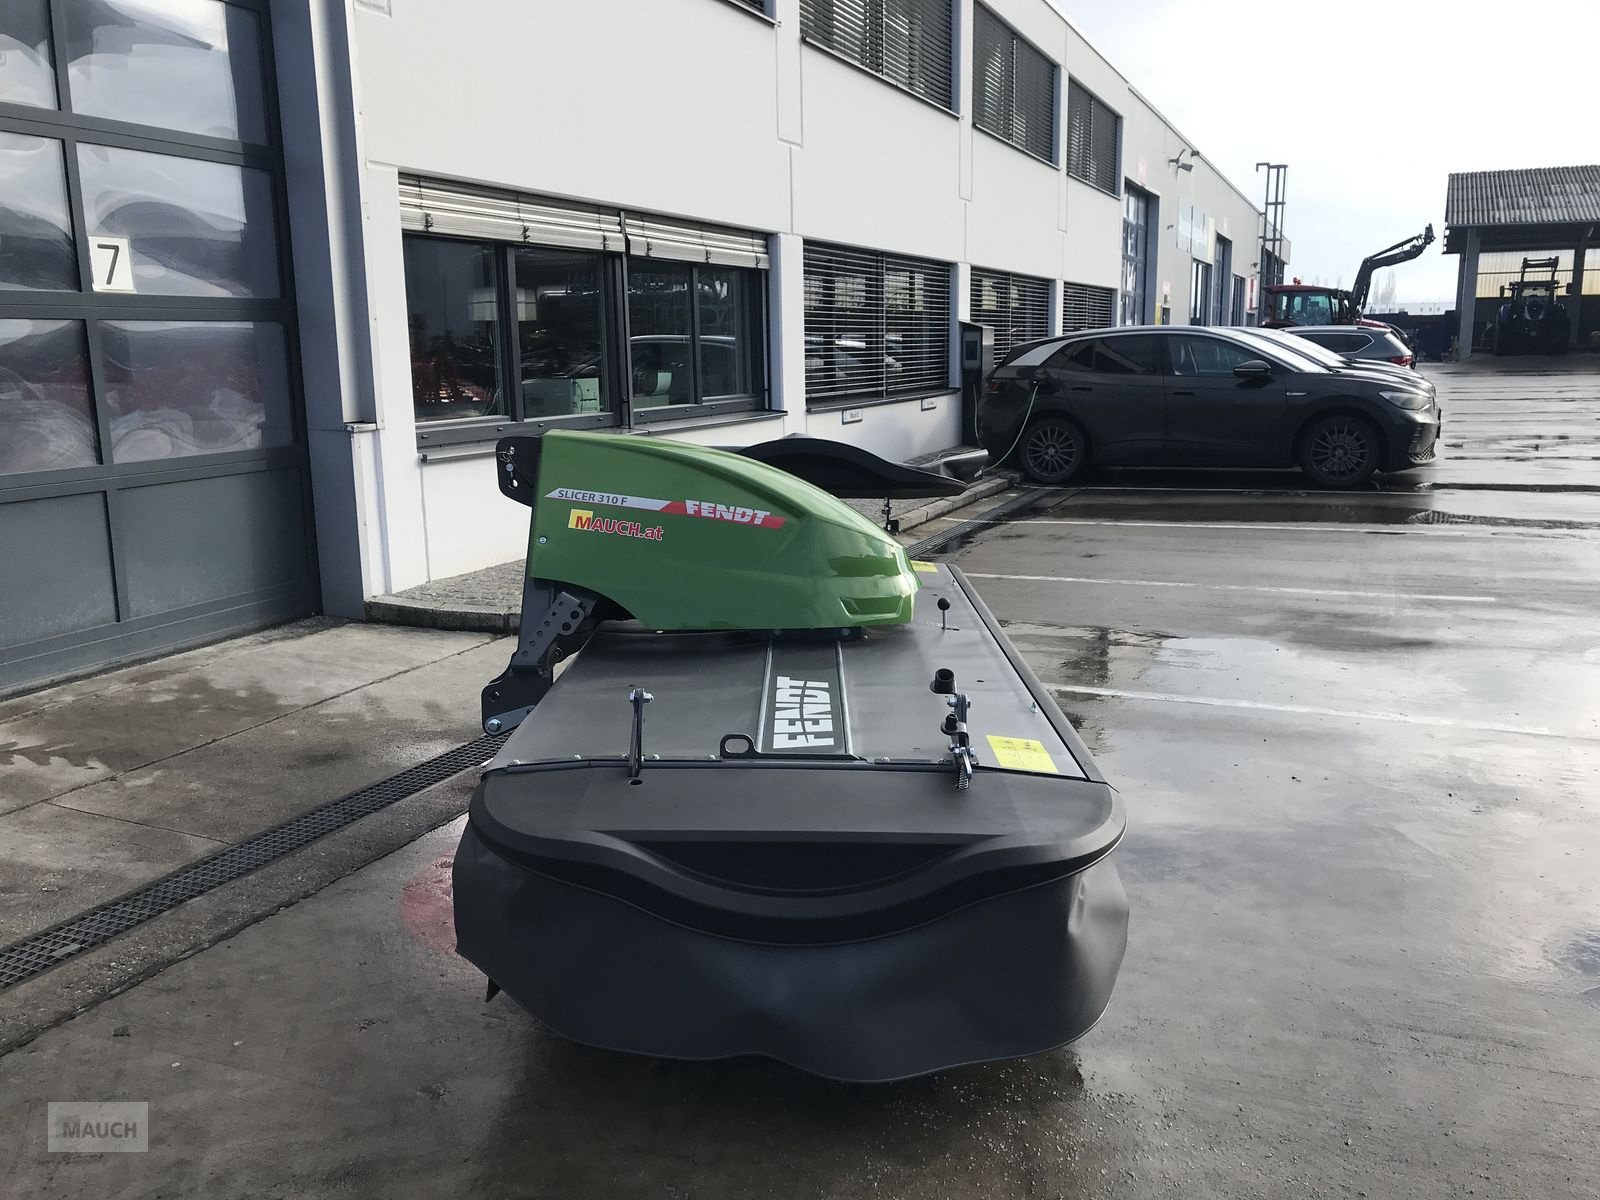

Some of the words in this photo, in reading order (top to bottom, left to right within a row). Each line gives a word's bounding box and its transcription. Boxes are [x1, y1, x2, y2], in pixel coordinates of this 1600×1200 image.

[97, 243, 120, 285] 7
[557, 489, 596, 503] SLICER
[597, 494, 619, 505] 310
[620, 496, 628, 506] F
[684, 499, 771, 525] FENDT
[574, 514, 664, 541] MAUCH.at
[773, 676, 835, 749] FENDT
